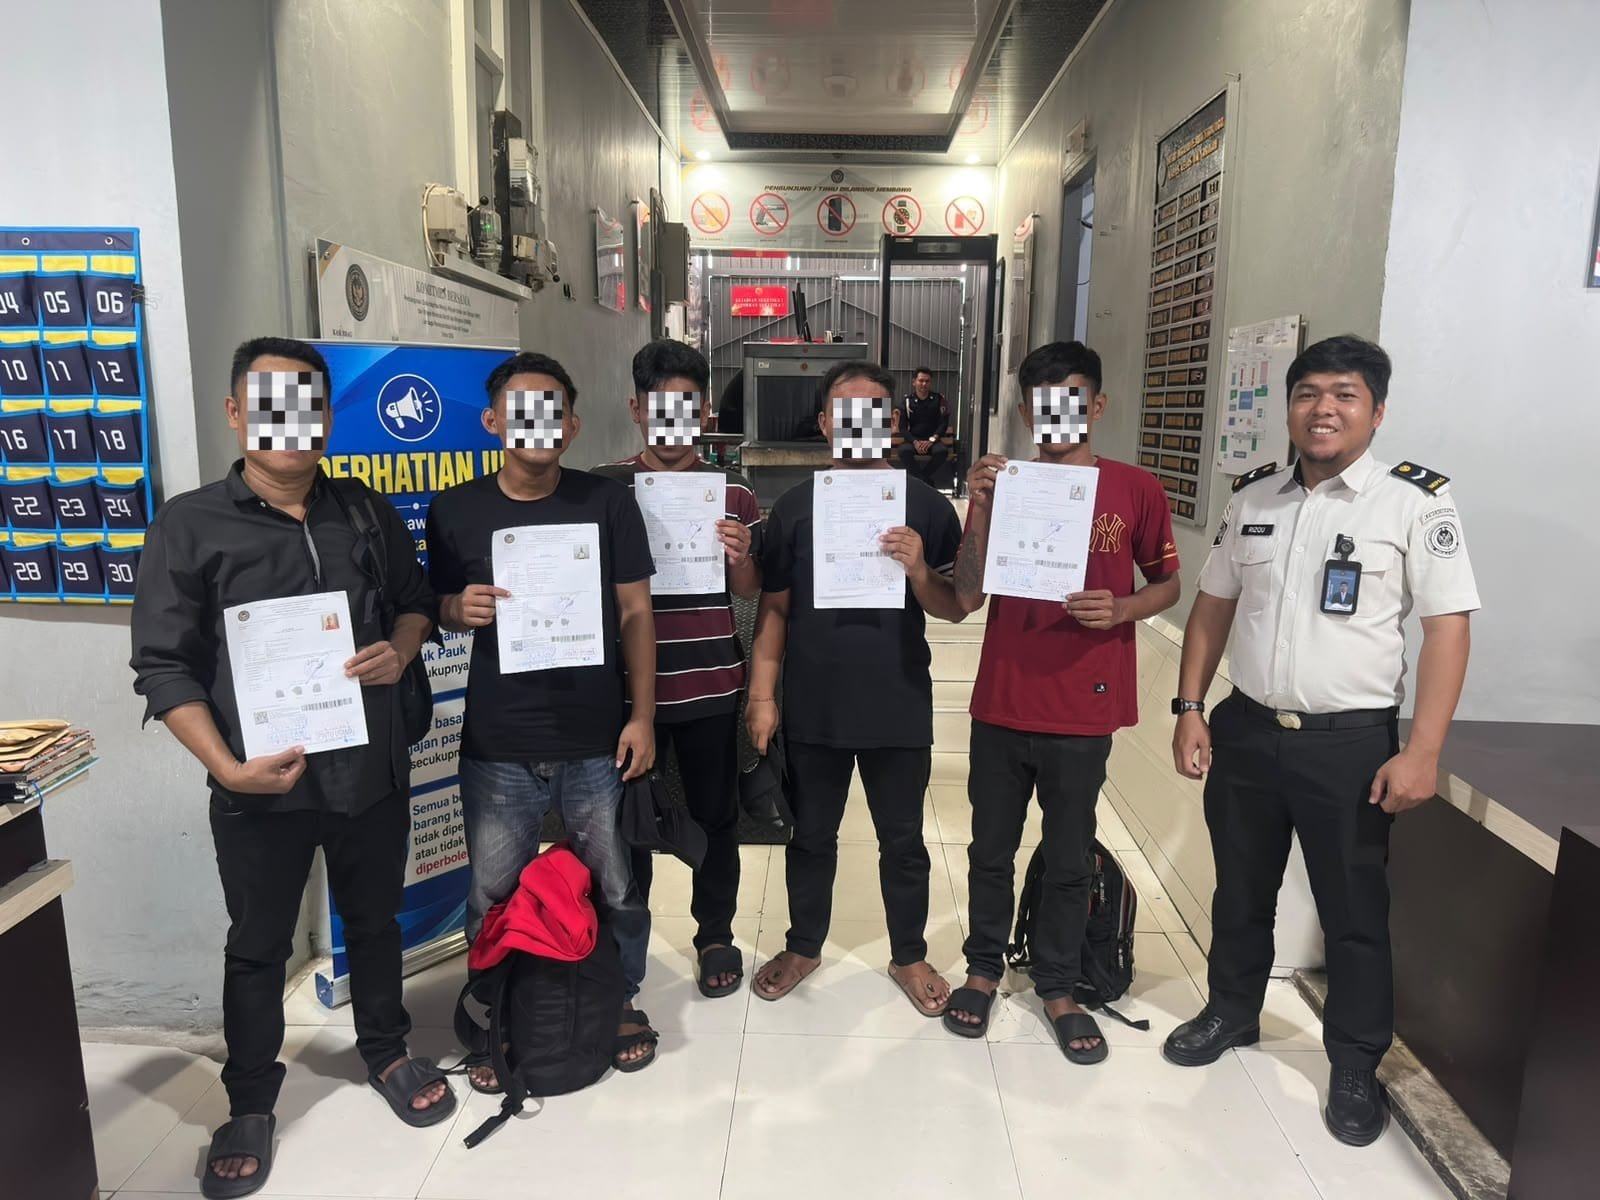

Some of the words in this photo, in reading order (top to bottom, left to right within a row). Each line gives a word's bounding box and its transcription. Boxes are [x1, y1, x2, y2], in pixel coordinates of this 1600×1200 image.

[43, 291, 70, 313] 05
[96, 291, 124, 313] 06
[1, 360, 28, 380] 10
[46, 360, 71, 381] 11
[97, 361, 124, 382] 12
[1, 429, 28, 450] 16
[53, 429, 77, 450] 17
[99, 430, 126, 450] 18
[11, 497, 42, 515] 22
[57, 498, 86, 517] 23
[103, 498, 132, 517] 24
[13, 562, 42, 581] 28
[62, 562, 90, 581] 29
[107, 563, 134, 583] 30
[438, 644, 467, 659] Pauk
[435, 715, 462, 729] basa
[441, 732, 461, 748] pas
[410, 750, 460, 769] secukupn
[412, 798, 449, 816] Semua
[413, 813, 450, 831] barang
[414, 830, 440, 846] tidak
[442, 824, 464, 836] dipe
[415, 846, 437, 860] atau
[440, 836, 465, 852] tidak
[416, 851, 467, 875] diperbole
